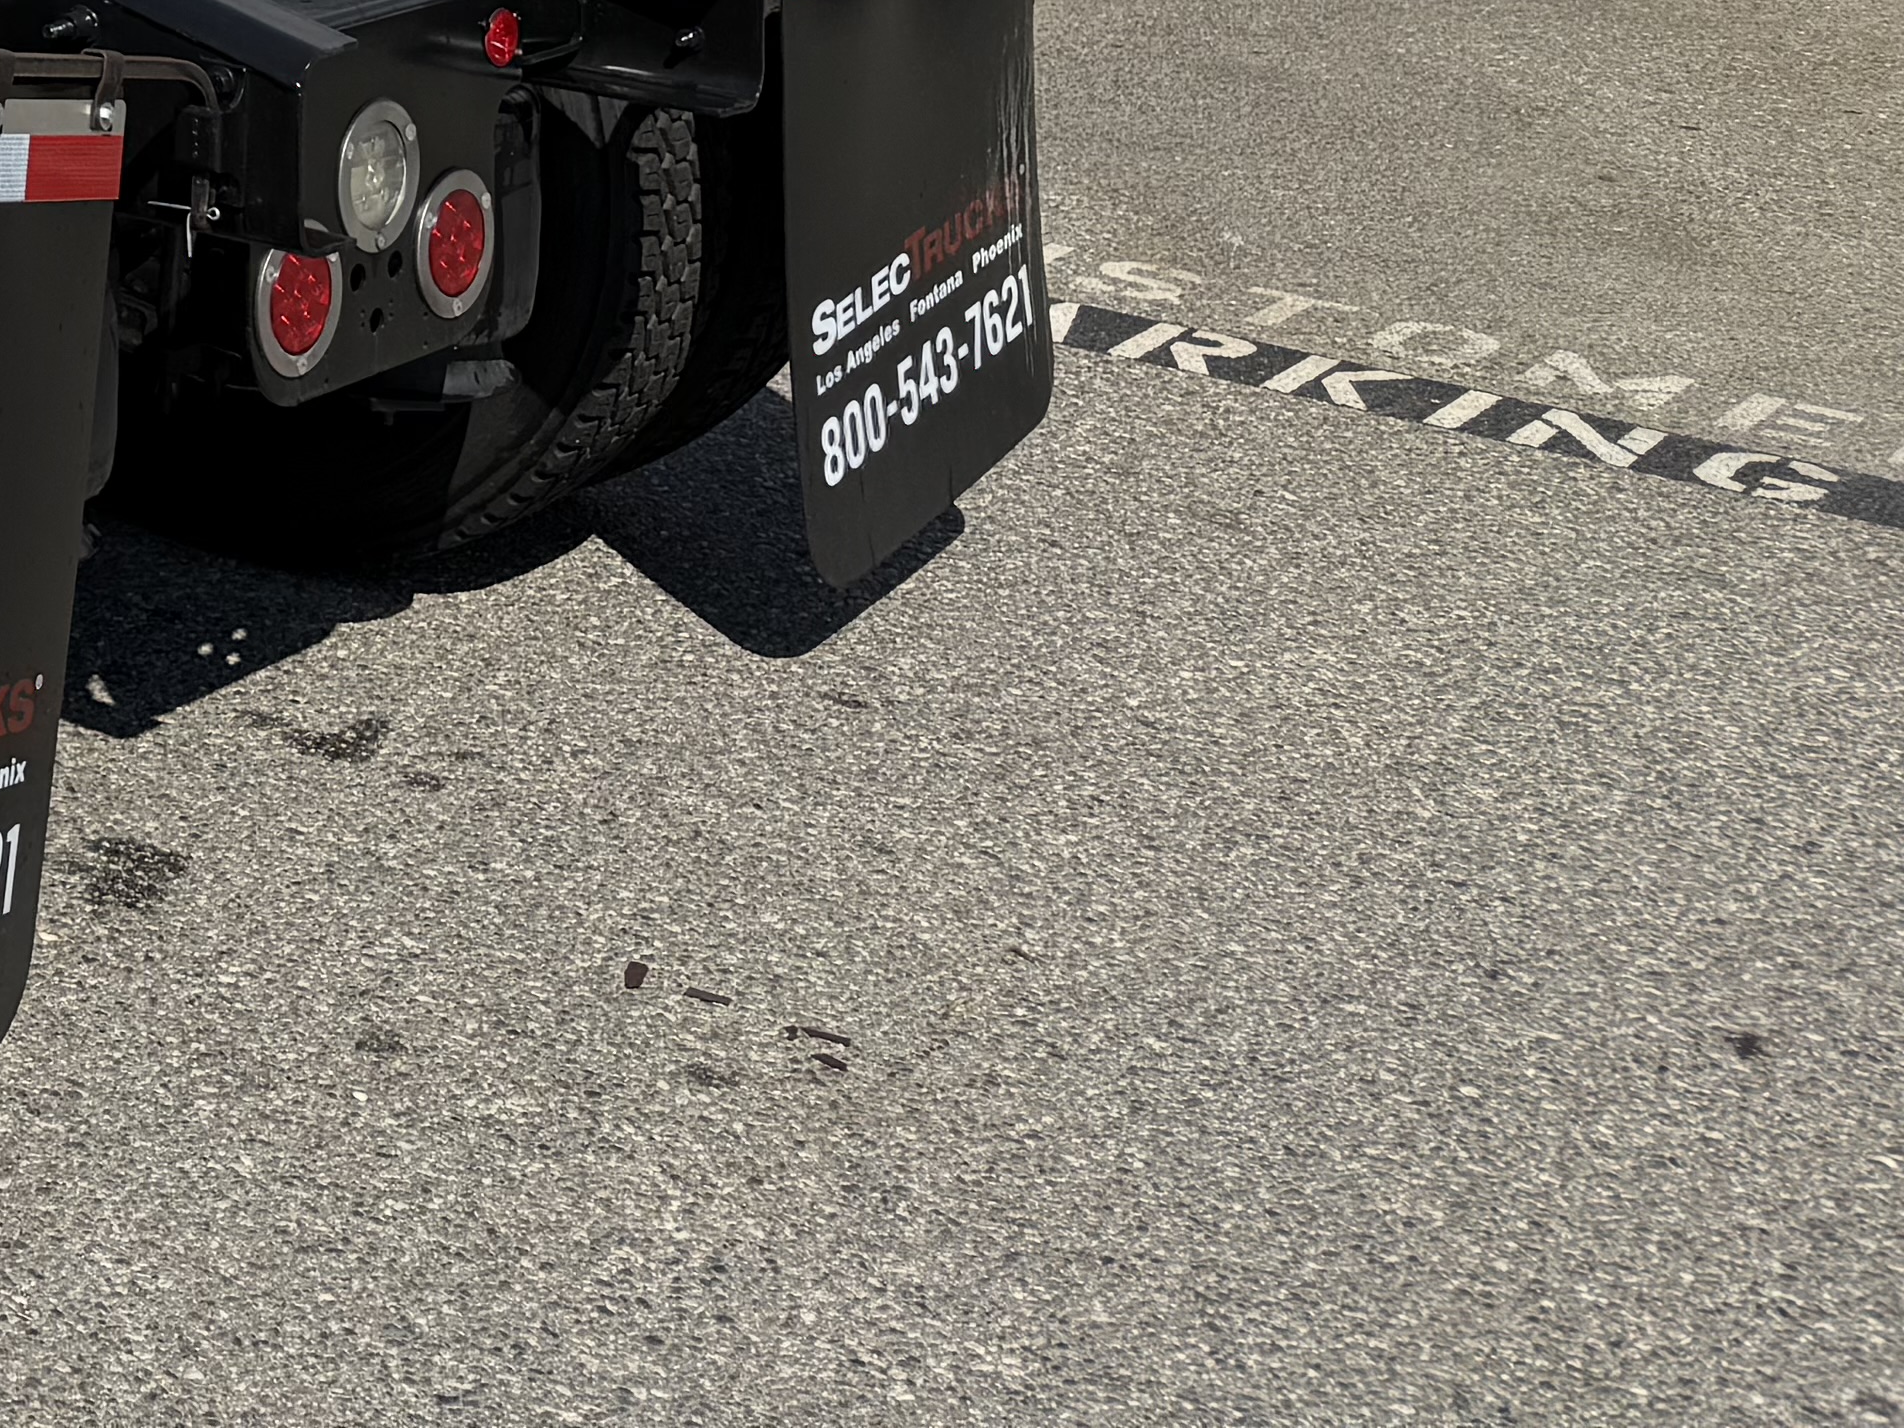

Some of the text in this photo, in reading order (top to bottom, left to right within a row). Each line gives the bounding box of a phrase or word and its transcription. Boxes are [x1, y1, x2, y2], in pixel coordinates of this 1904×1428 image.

[815, 221, 1024, 396] Los Angeles Fontana Phoenix
[820, 262, 1034, 488] 800-543-7621
[1042, 243, 1904, 481] STOME
